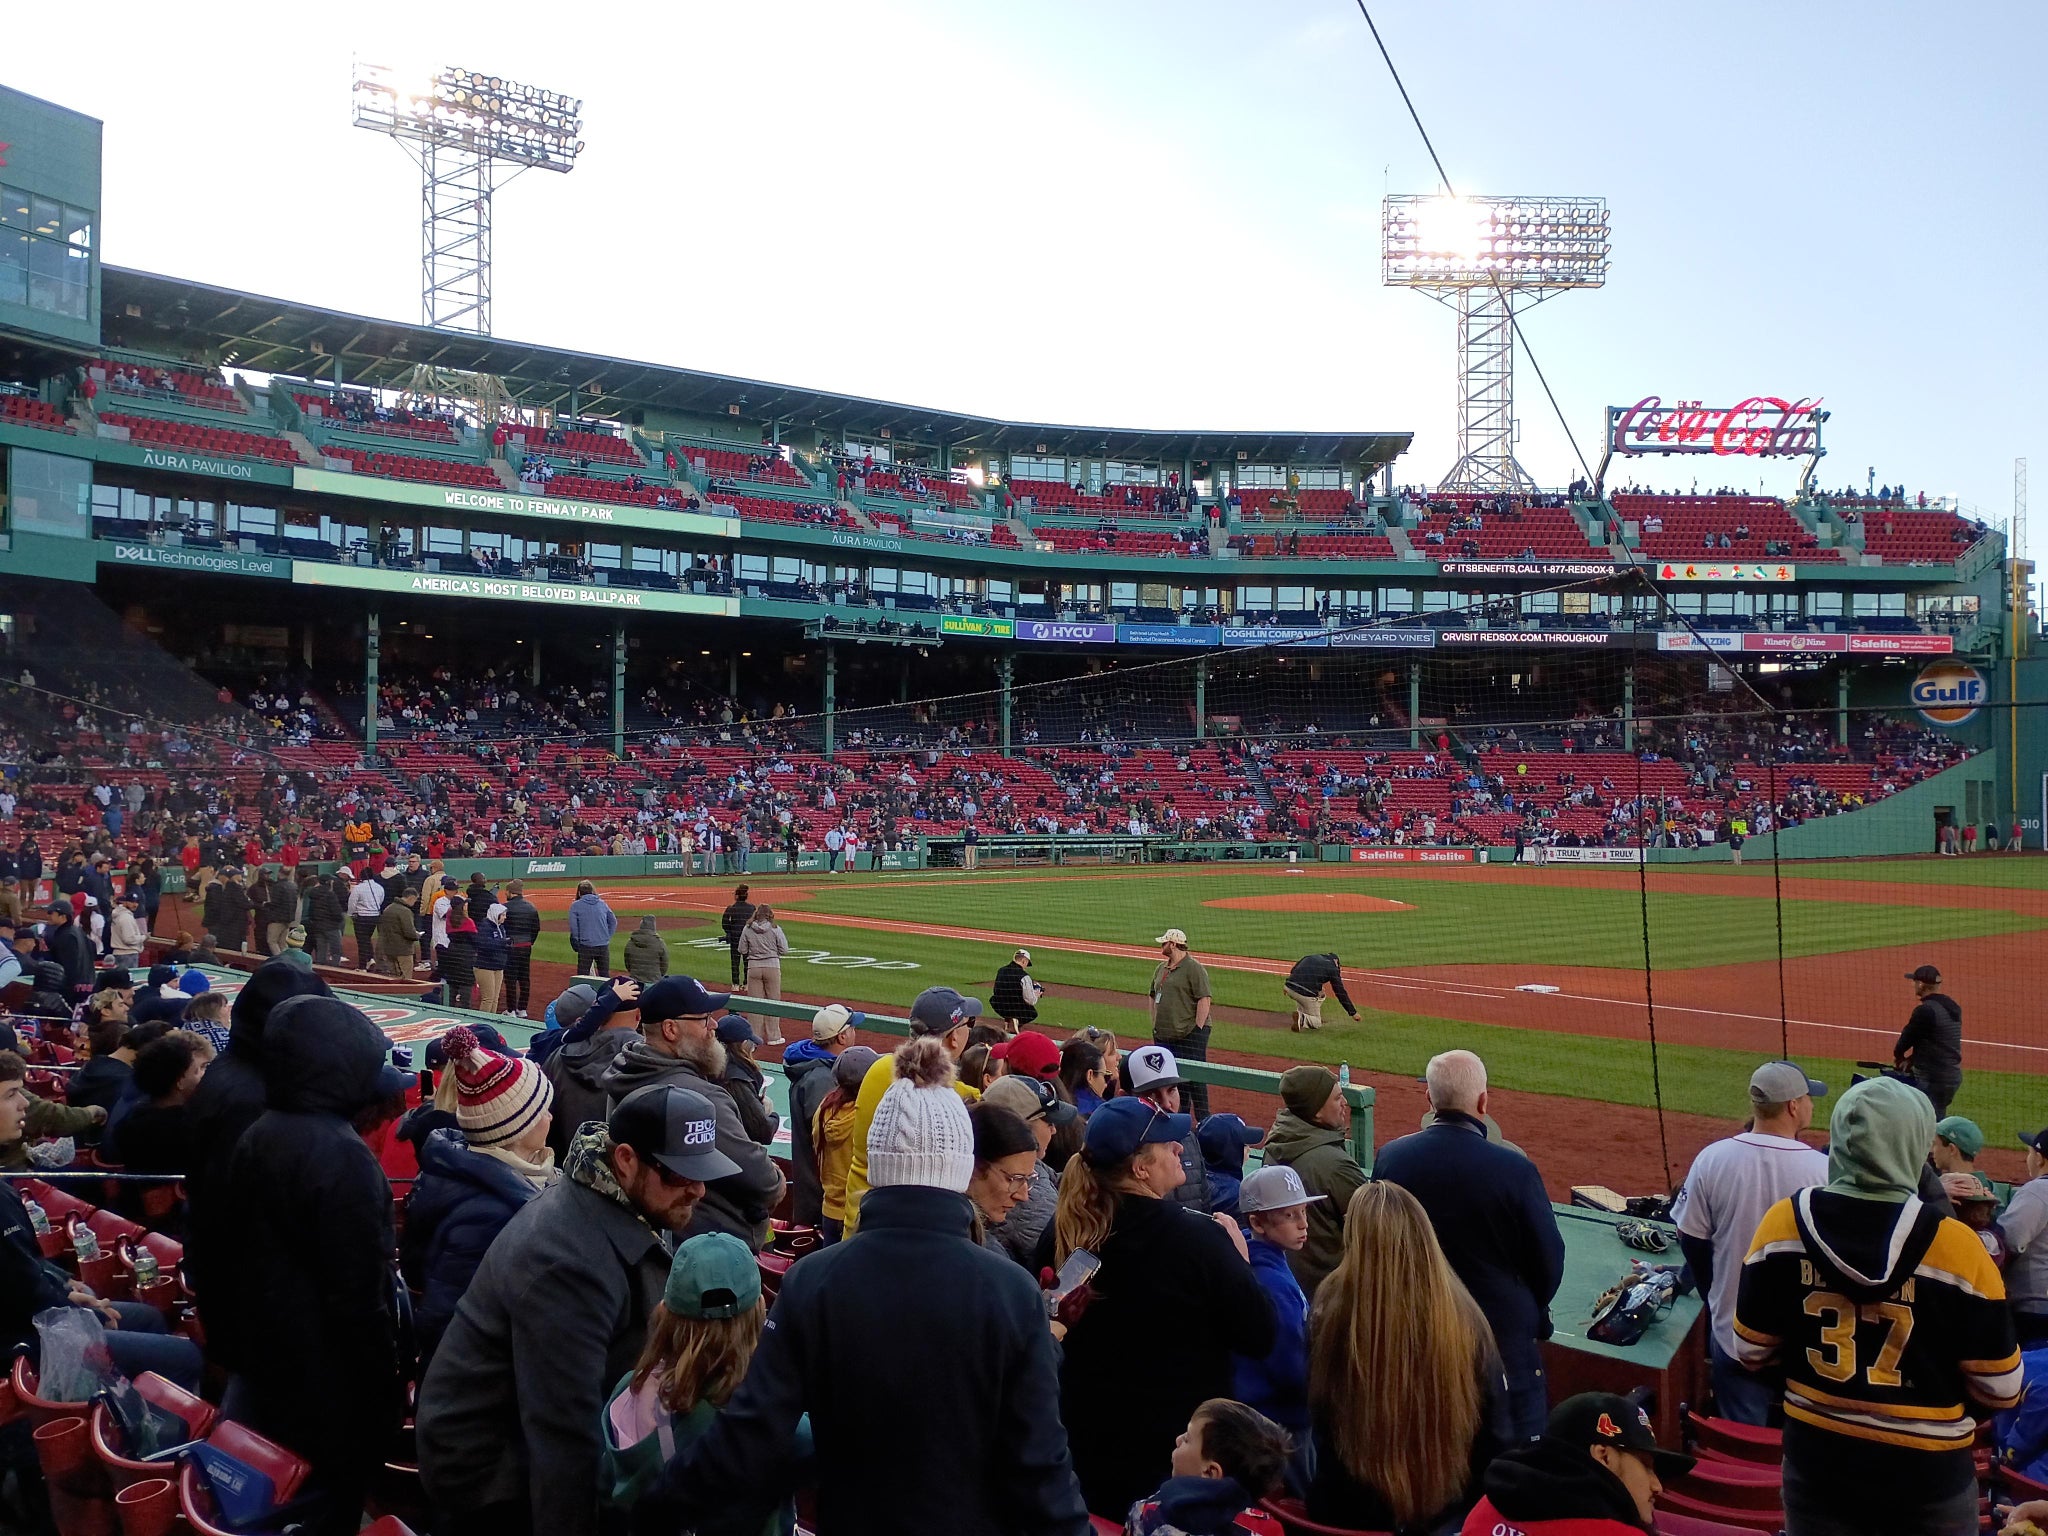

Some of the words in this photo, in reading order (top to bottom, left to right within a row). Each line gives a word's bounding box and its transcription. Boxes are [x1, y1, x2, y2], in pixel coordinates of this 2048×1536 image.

[192, 459, 251, 478] PAVILION
[444, 491, 504, 509] WELCOME
[509, 498, 524, 511] TO
[528, 500, 578, 517] FENWAY
[581, 506, 613, 520] PARK
[862, 537, 902, 550] PAVILION
[156, 550, 238, 570] Technologies
[241, 558, 273, 573] Level
[1442, 564, 1456, 572] OF
[1457, 564, 1540, 574] ITSBENEFITS,CALL
[1542, 565, 1615, 574] 1-877-REDSOX-9
[411, 577, 480, 593] AMERICA'S
[484, 582, 516, 596] MOST
[522, 586, 576, 601] BELOVED
[580, 590, 641, 606] BALLPARK
[944, 619, 982, 633] SULLIVAN
[993, 624, 1011, 634] TIRE
[1052, 626, 1092, 638] HYCU
[1225, 630, 1267, 638] COGHLIN
[1342, 633, 1398, 642] VINEYARD
[1398, 634, 1430, 642] VINES
[1442, 633, 1478, 642] ORVISIT
[1480, 633, 1608, 643] REDSOX.COM.THROUGHOUT
[1764, 638, 1790, 646] Ninety
[1806, 638, 1826, 646] Nine
[1852, 638, 1900, 649] Safelite
[1914, 680, 1980, 701] Gulf
[2020, 818, 2040, 830] 310
[1359, 851, 1404, 860] Safelite
[1420, 852, 1466, 861] Safelite
[1610, 850, 1634, 858] TRULY
[654, 860, 701, 870] smartwer
[1802, 1290, 1914, 1387] 37
